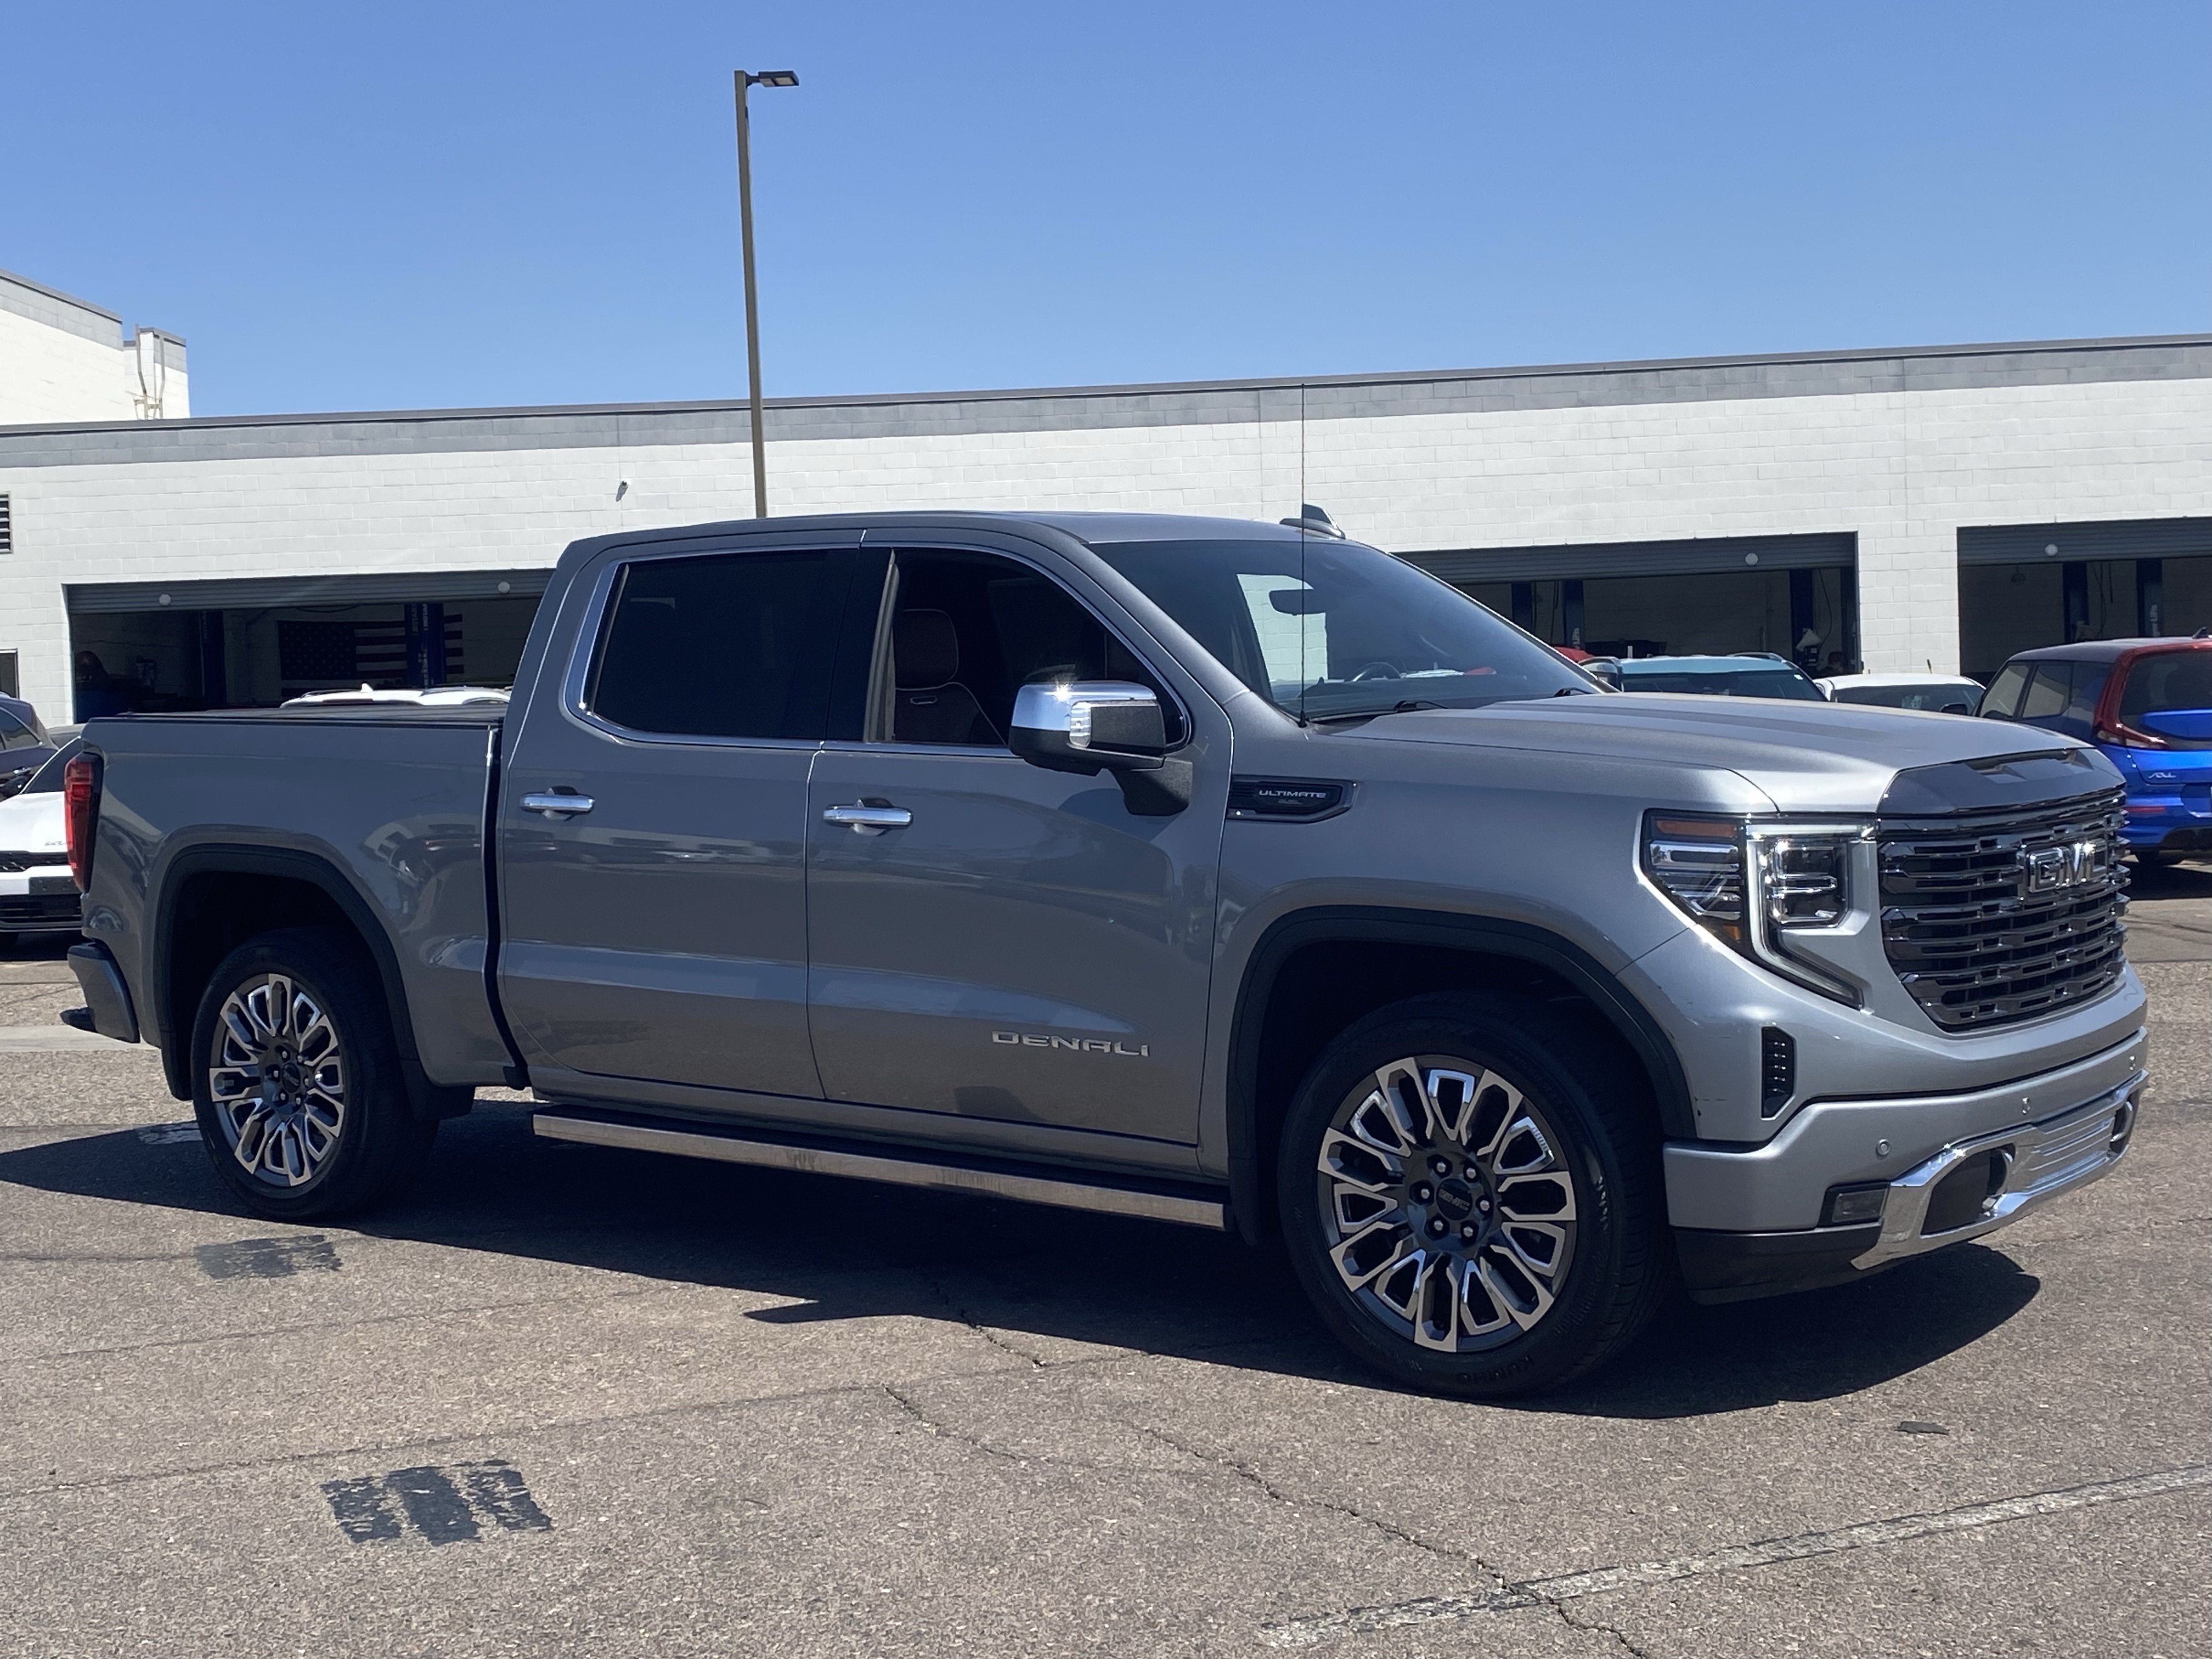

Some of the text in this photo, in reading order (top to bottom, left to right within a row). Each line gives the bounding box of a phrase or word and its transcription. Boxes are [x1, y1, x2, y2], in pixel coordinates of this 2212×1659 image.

[1259, 789, 1327, 798] ULTIMATE
[2025, 838, 2108, 893] GMC
[992, 1030, 1150, 1057] DENALI
[1438, 1188, 1471, 1211] GMC
